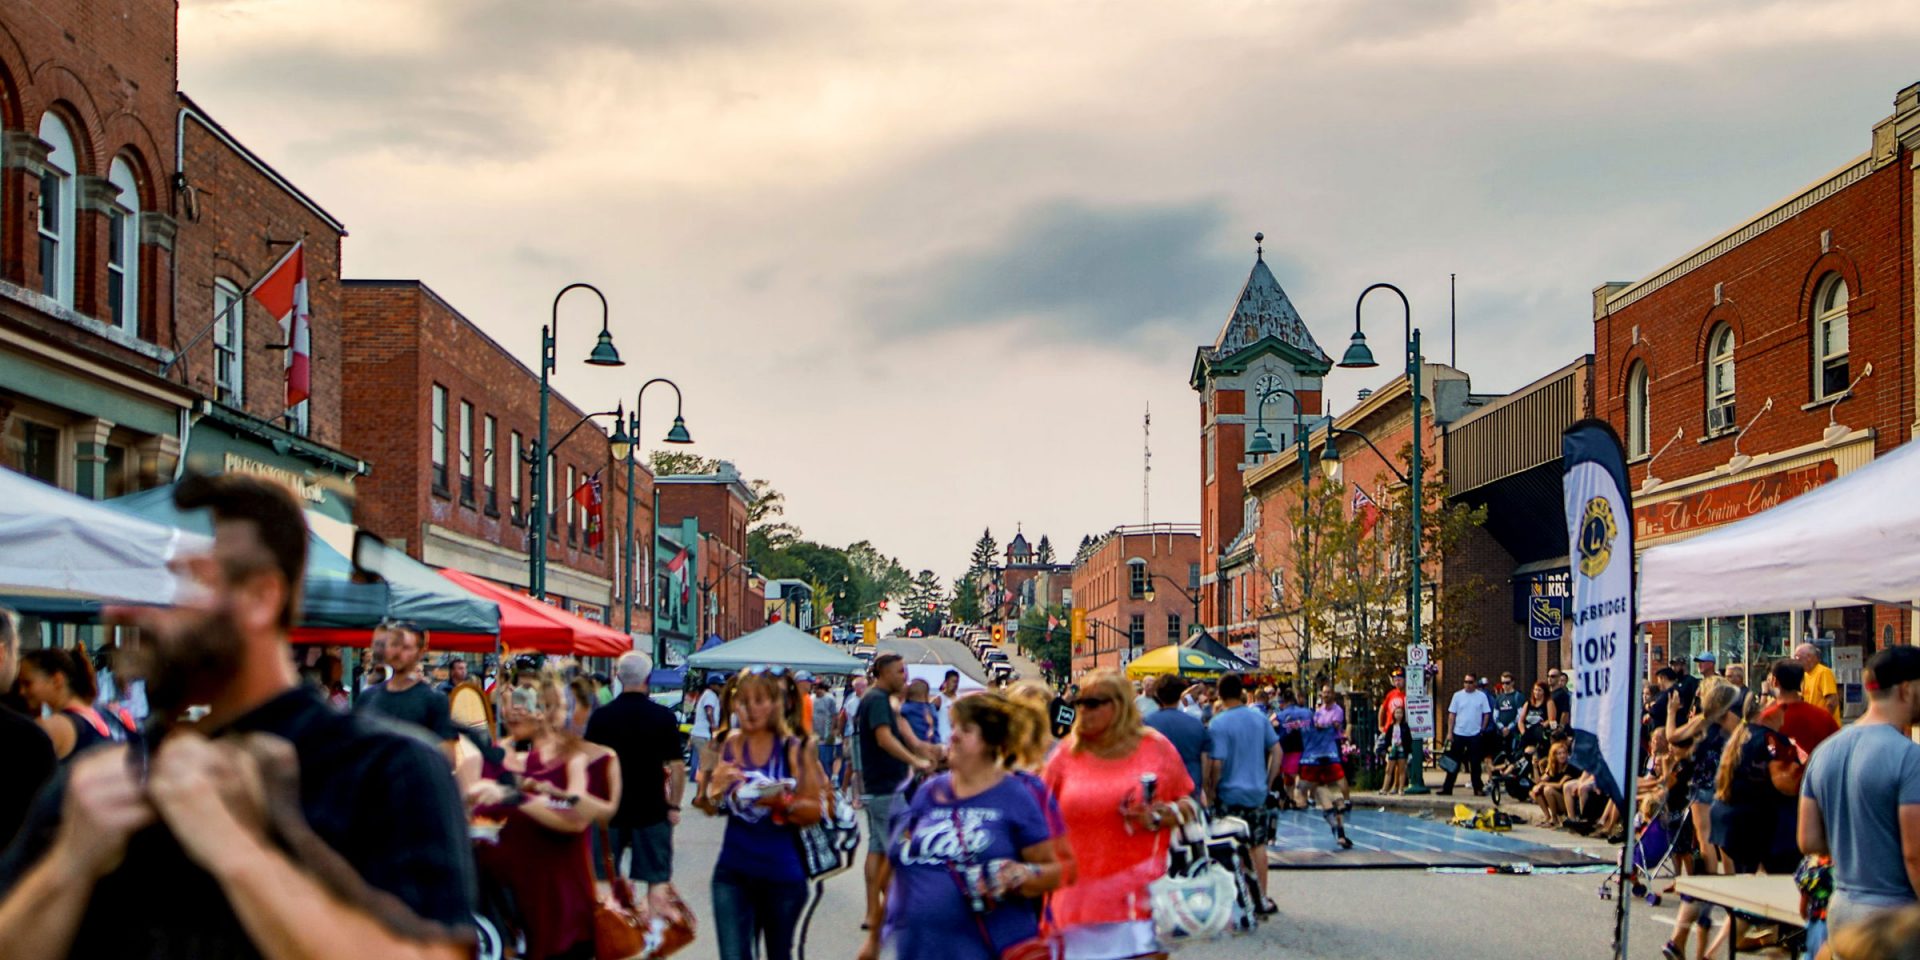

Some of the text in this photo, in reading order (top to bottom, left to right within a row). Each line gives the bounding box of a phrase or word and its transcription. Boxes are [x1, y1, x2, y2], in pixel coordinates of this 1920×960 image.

[1663, 480, 1782, 530] The Creative Cook
[1548, 573, 1570, 597] RBC
[1534, 627, 1560, 637] RBC
[1578, 632, 1616, 666] IONS
